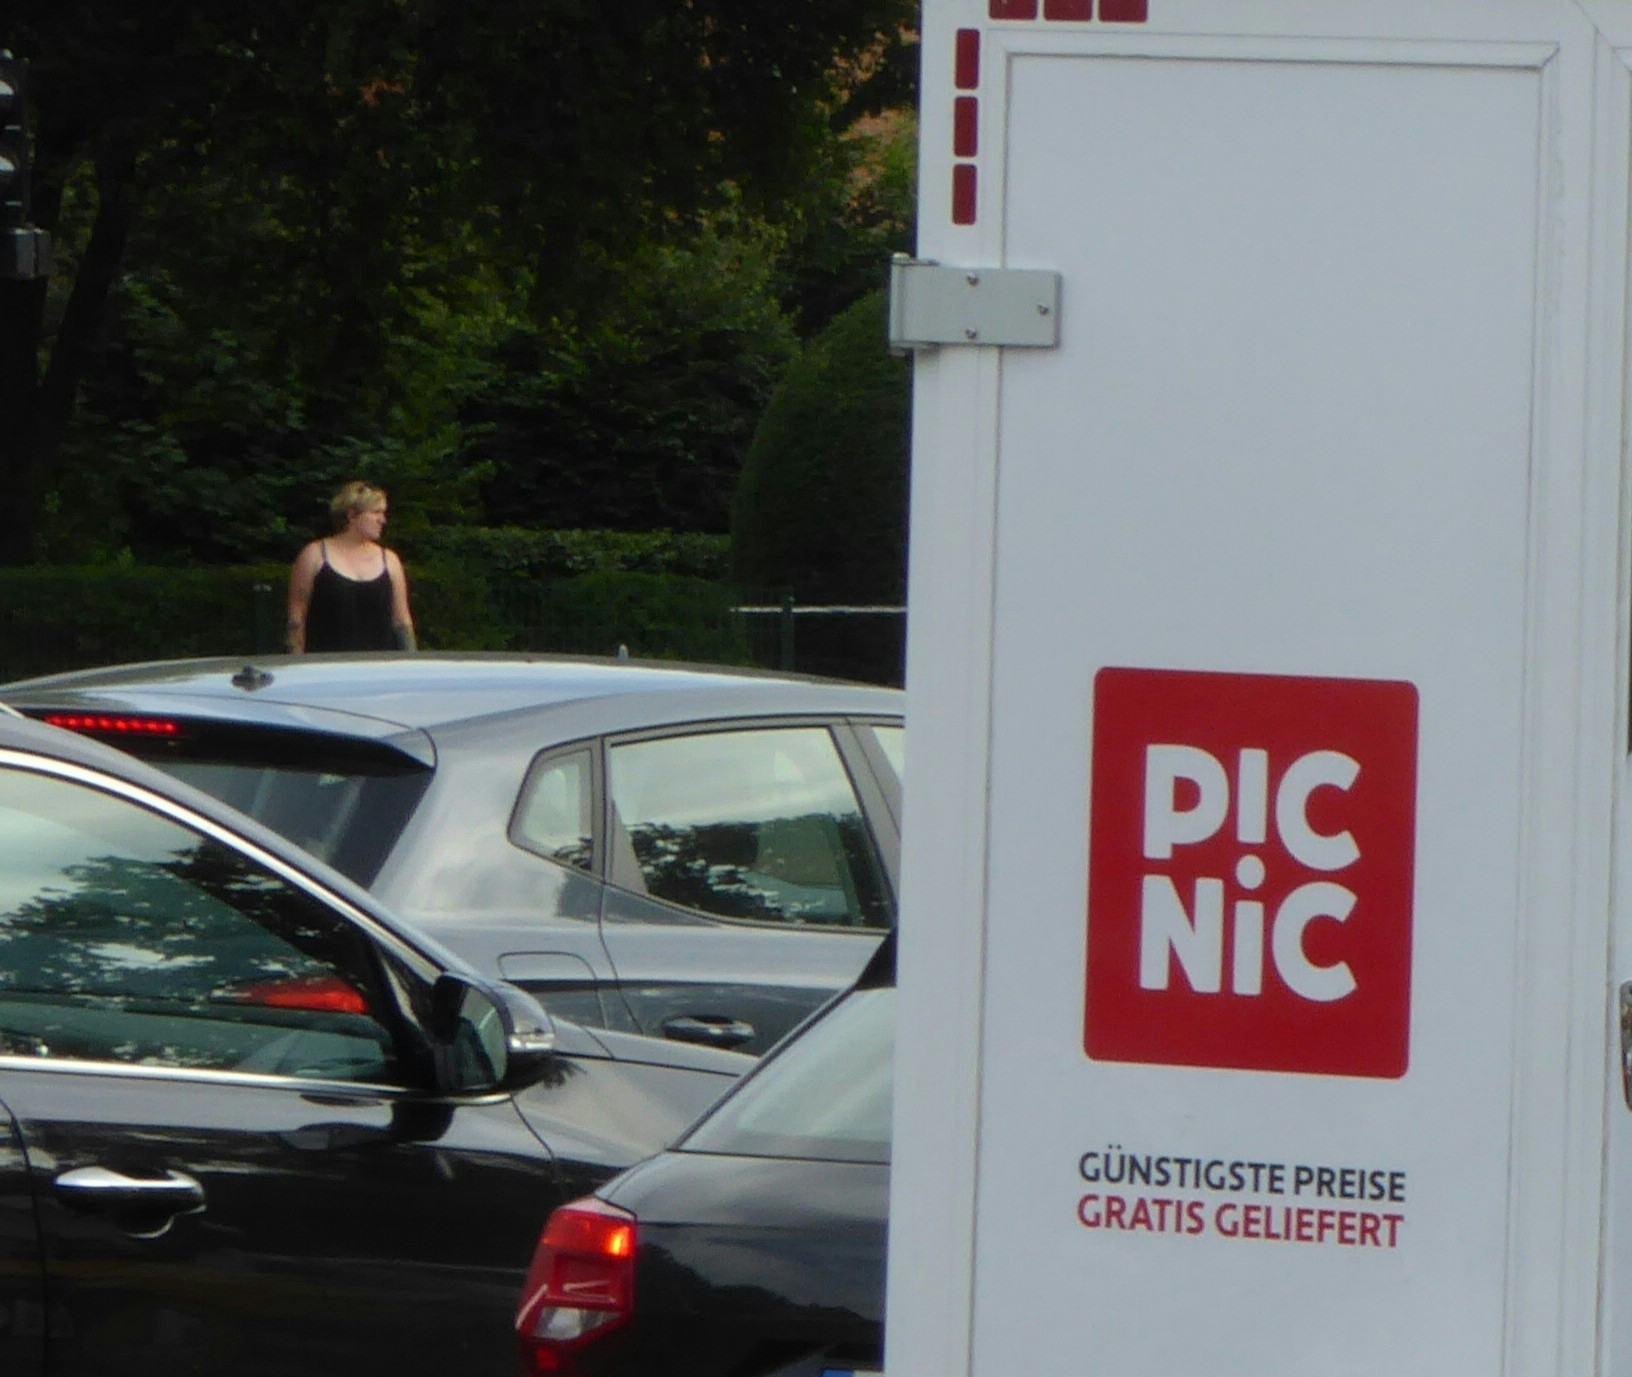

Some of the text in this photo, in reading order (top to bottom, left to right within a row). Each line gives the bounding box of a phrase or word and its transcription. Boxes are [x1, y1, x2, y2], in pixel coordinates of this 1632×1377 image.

[1143, 743, 1362, 872] PIC
[1078, 1143, 1406, 1203] GÜNSTIGSTE PREISE
[1076, 1193, 1406, 1249] GRATIS GELIEFERT
